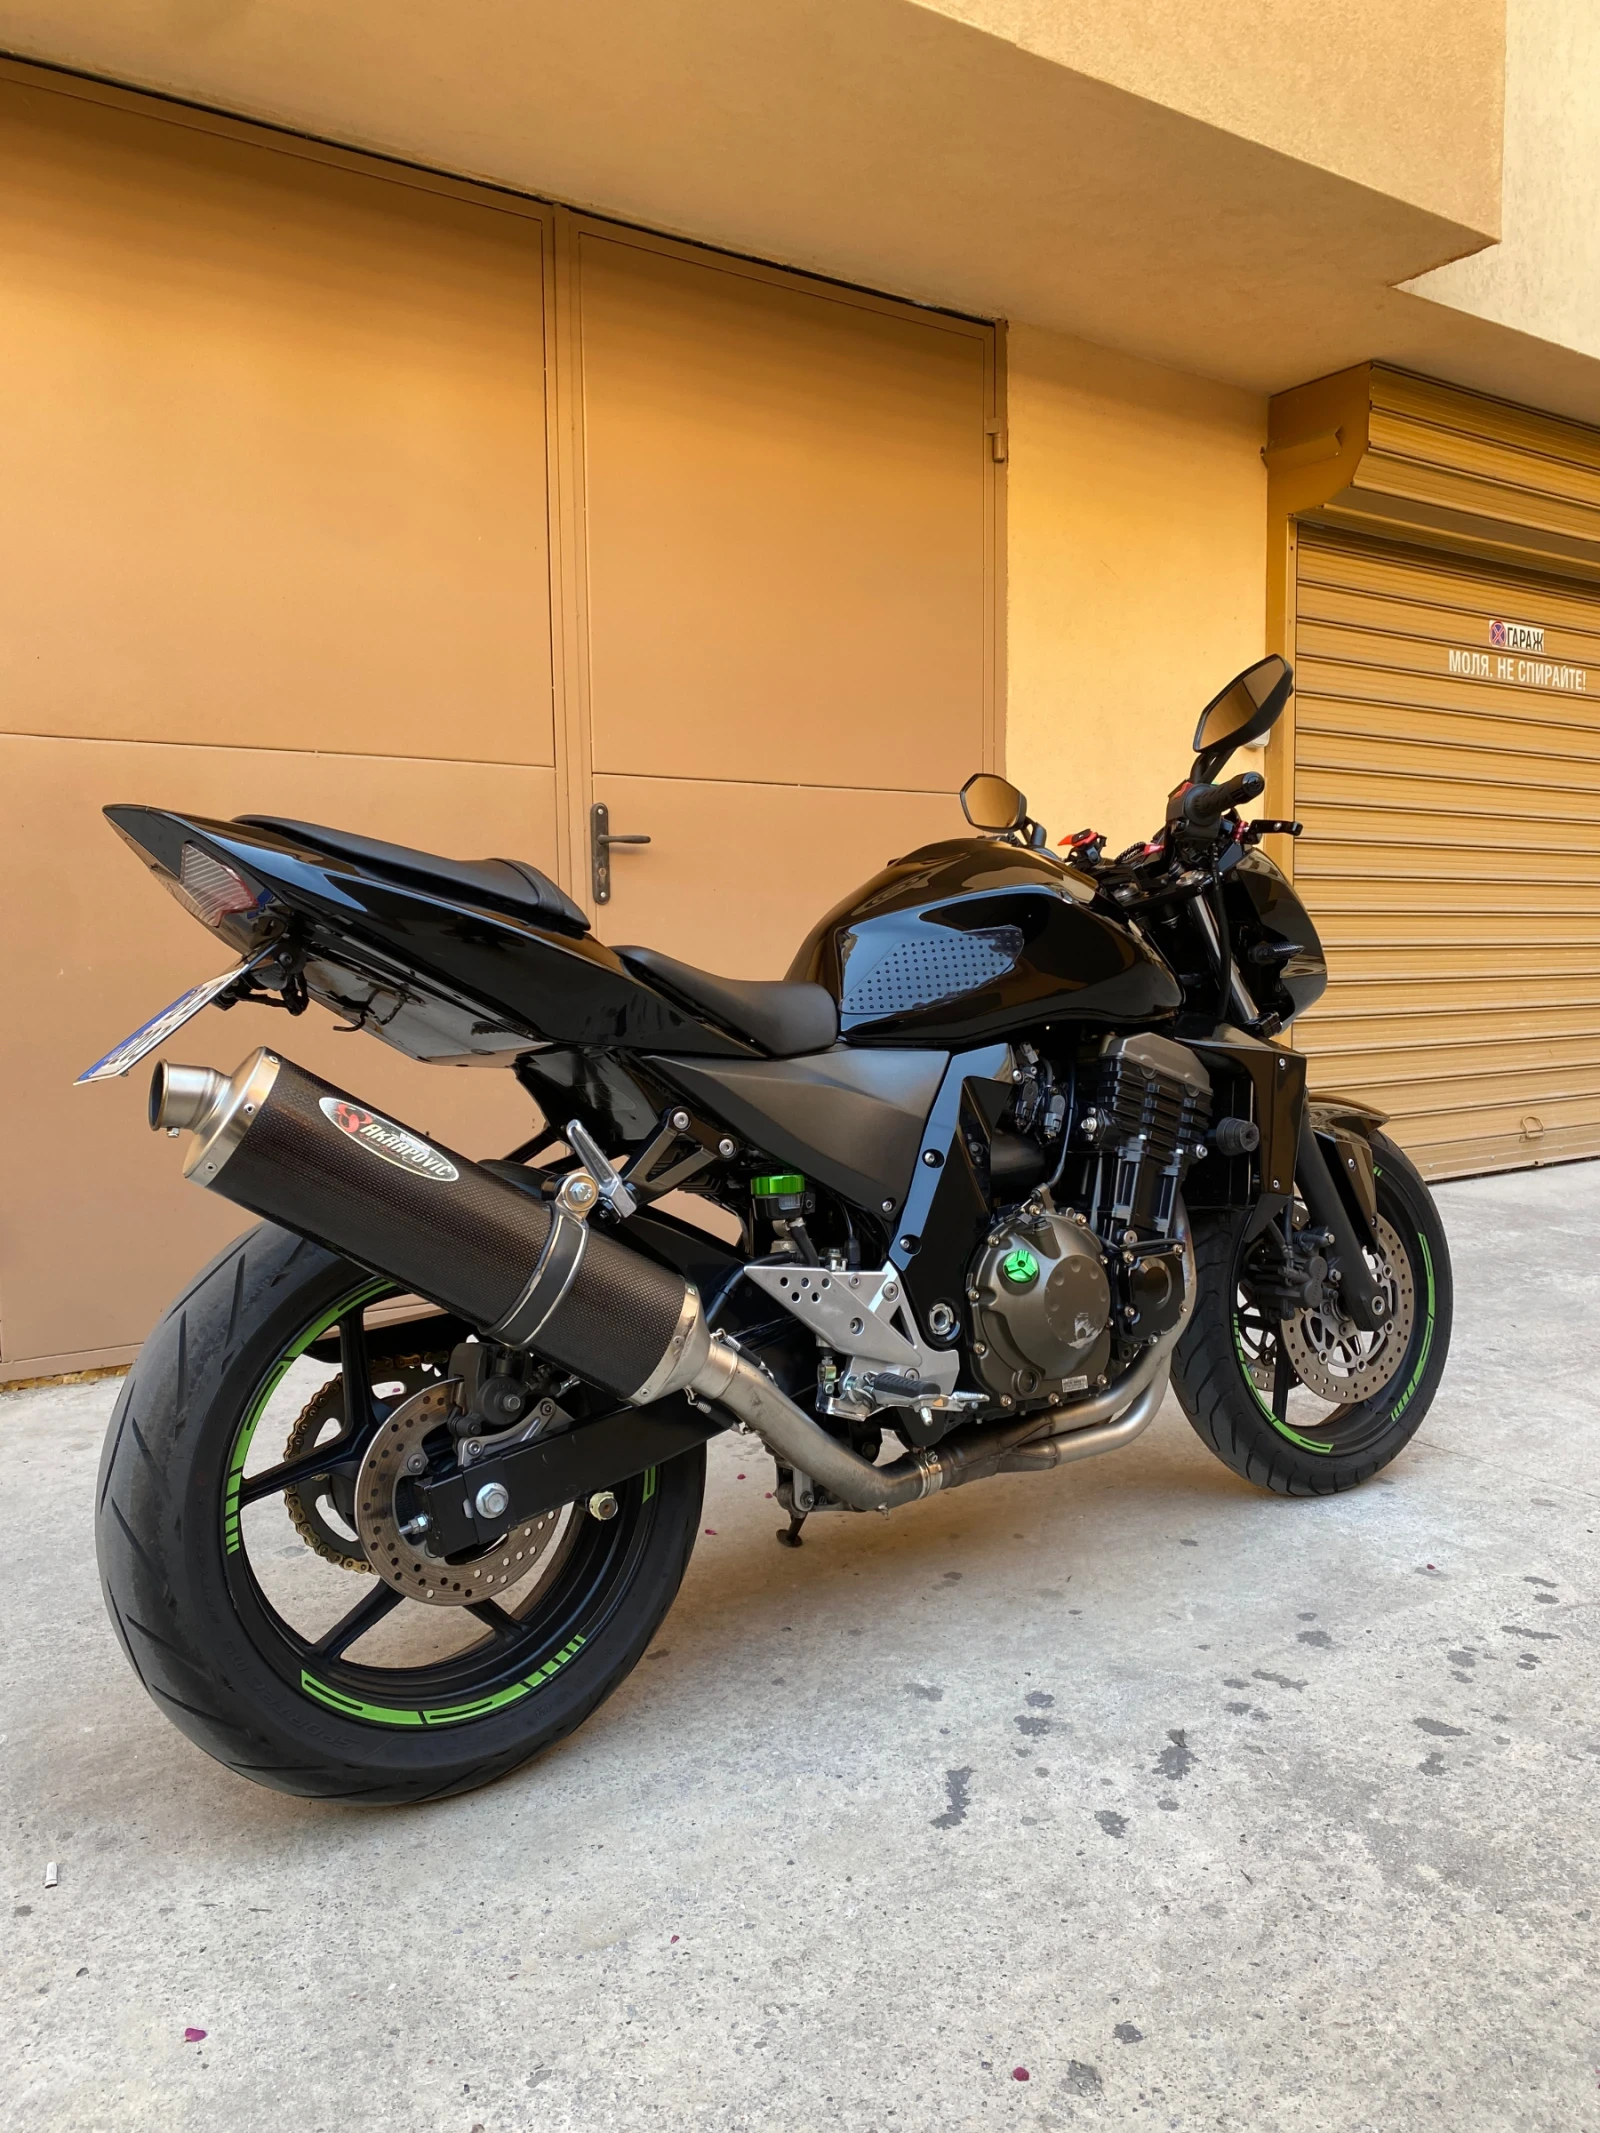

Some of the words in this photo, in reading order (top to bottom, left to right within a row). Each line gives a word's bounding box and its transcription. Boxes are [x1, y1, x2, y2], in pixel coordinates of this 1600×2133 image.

[1507, 627, 1544, 653] ГАРАЖ
[1497, 657, 1514, 681] НЕ
[1518, 660, 1586, 691] СПИРАЙТЕ!
